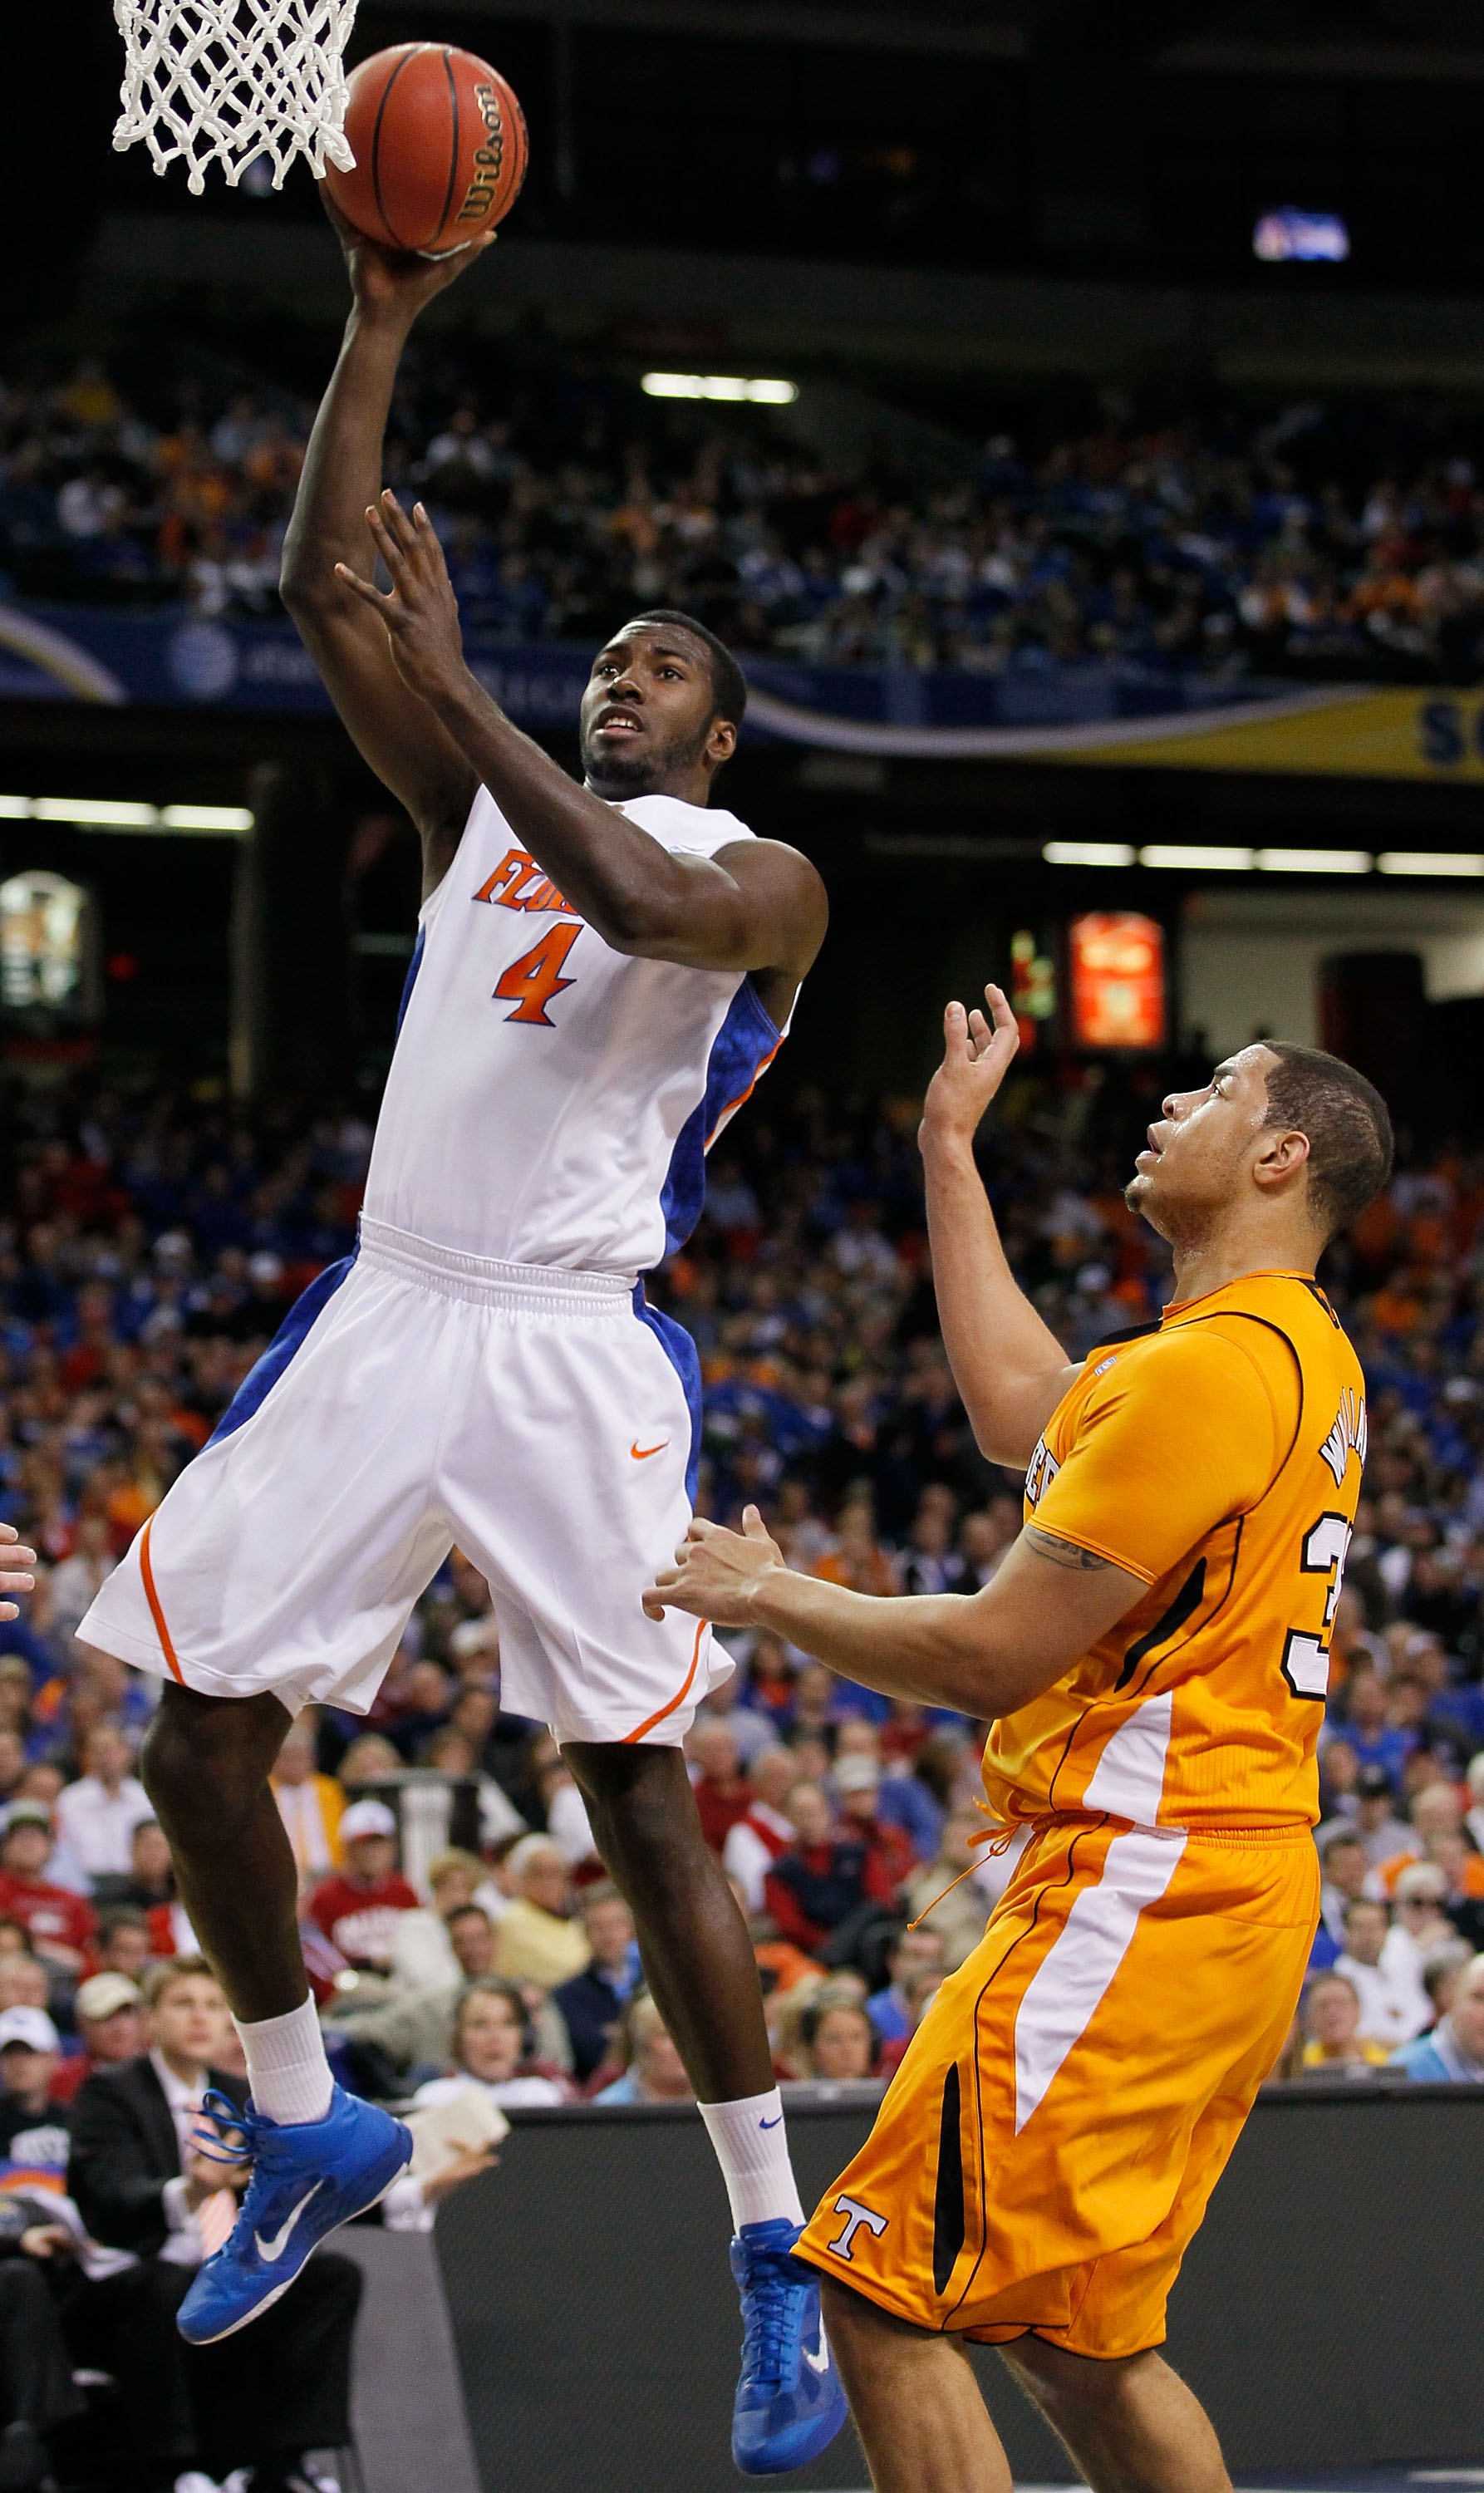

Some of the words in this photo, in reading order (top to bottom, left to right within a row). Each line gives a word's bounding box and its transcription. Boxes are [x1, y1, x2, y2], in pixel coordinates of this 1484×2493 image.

[457, 84, 503, 221] Wilson
[492, 922, 584, 1028] 4
[827, 2194, 890, 2262] T
